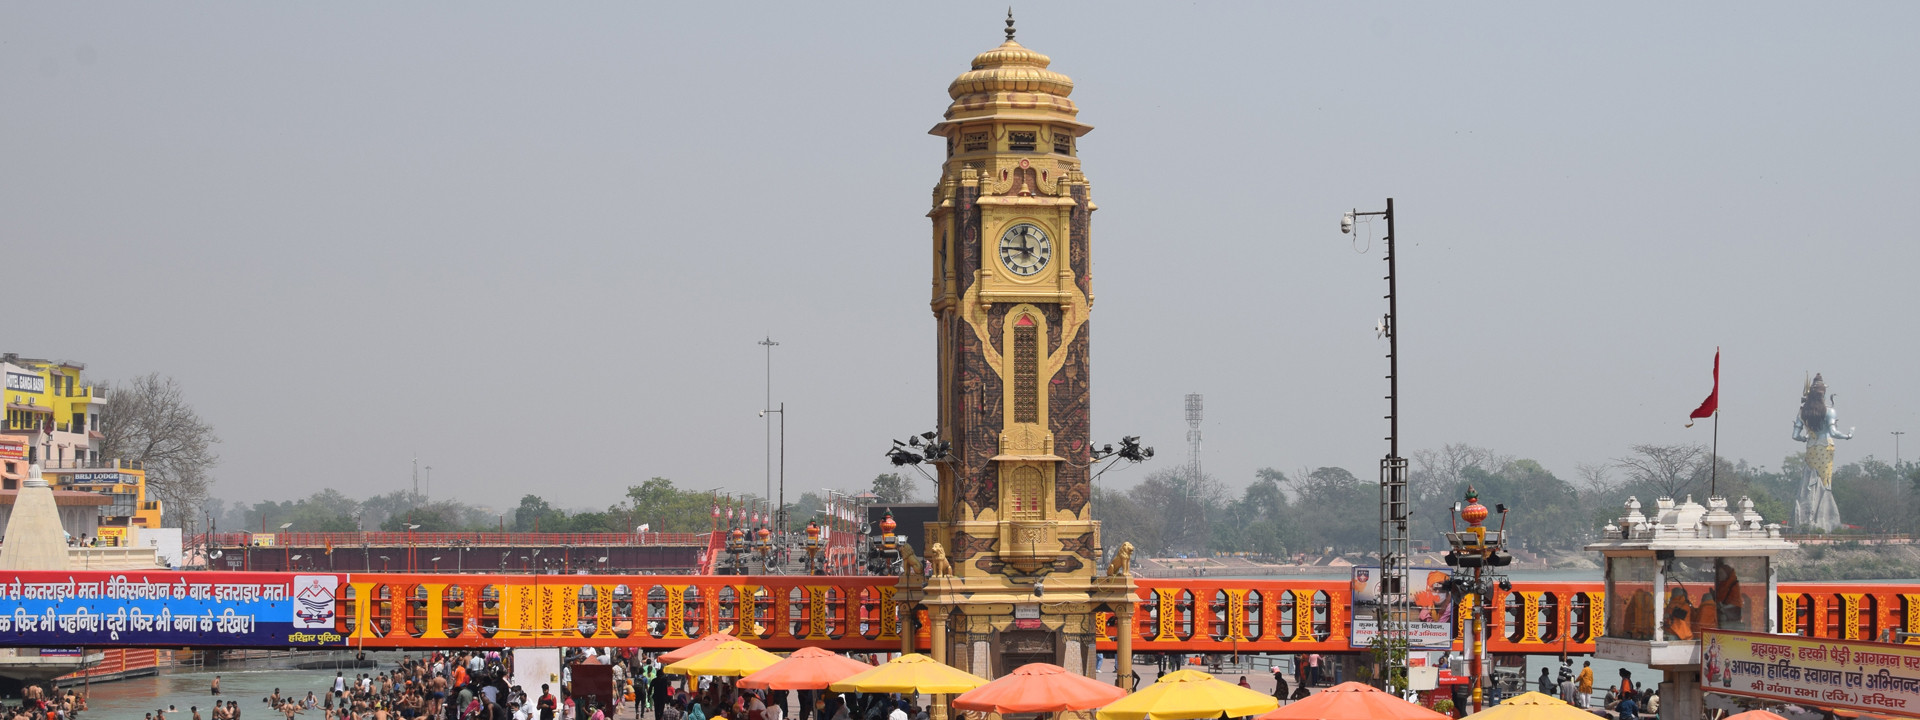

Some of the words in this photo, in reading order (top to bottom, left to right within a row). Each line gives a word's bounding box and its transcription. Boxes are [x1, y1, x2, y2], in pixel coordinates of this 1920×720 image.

[7, 374, 19, 388] HOTEL
[20, 375, 32, 389] GANGA
[9, 576, 22, 600] से
[24, 576, 75, 602] कतराइये
[107, 575, 171, 600] वैक्सिनेशन
[173, 576, 187, 600] के
[189, 583, 212, 601] बाद
[214, 583, 261, 604] इतराइए
[14, 607, 39, 632] फिर
[40, 607, 56, 632] भी
[107, 607, 127, 640] दूरी
[130, 607, 154, 632] फिर
[155, 607, 171, 632] भी
[174, 614, 197, 632] बना
[200, 608, 214, 632] के
[288, 631, 316, 643] हरिद्वार
[317, 631, 341, 645] पुलिस
[1798, 644, 1827, 660] हरकी
[1853, 652, 1900, 667] आगमन
[1731, 660, 1765, 675] आपका
[1767, 659, 1801, 680] हार्दिक
[1804, 667, 1842, 685] स्वागत
[1845, 666, 1863, 687] एवं
[1865, 669, 1920, 694] अभिनन्द
[1751, 680, 1764, 691] श्री
[1766, 683, 1791, 695] गंगा
[1794, 687, 1818, 698] सभा
[1862, 693, 1907, 708] हरिद्वार
